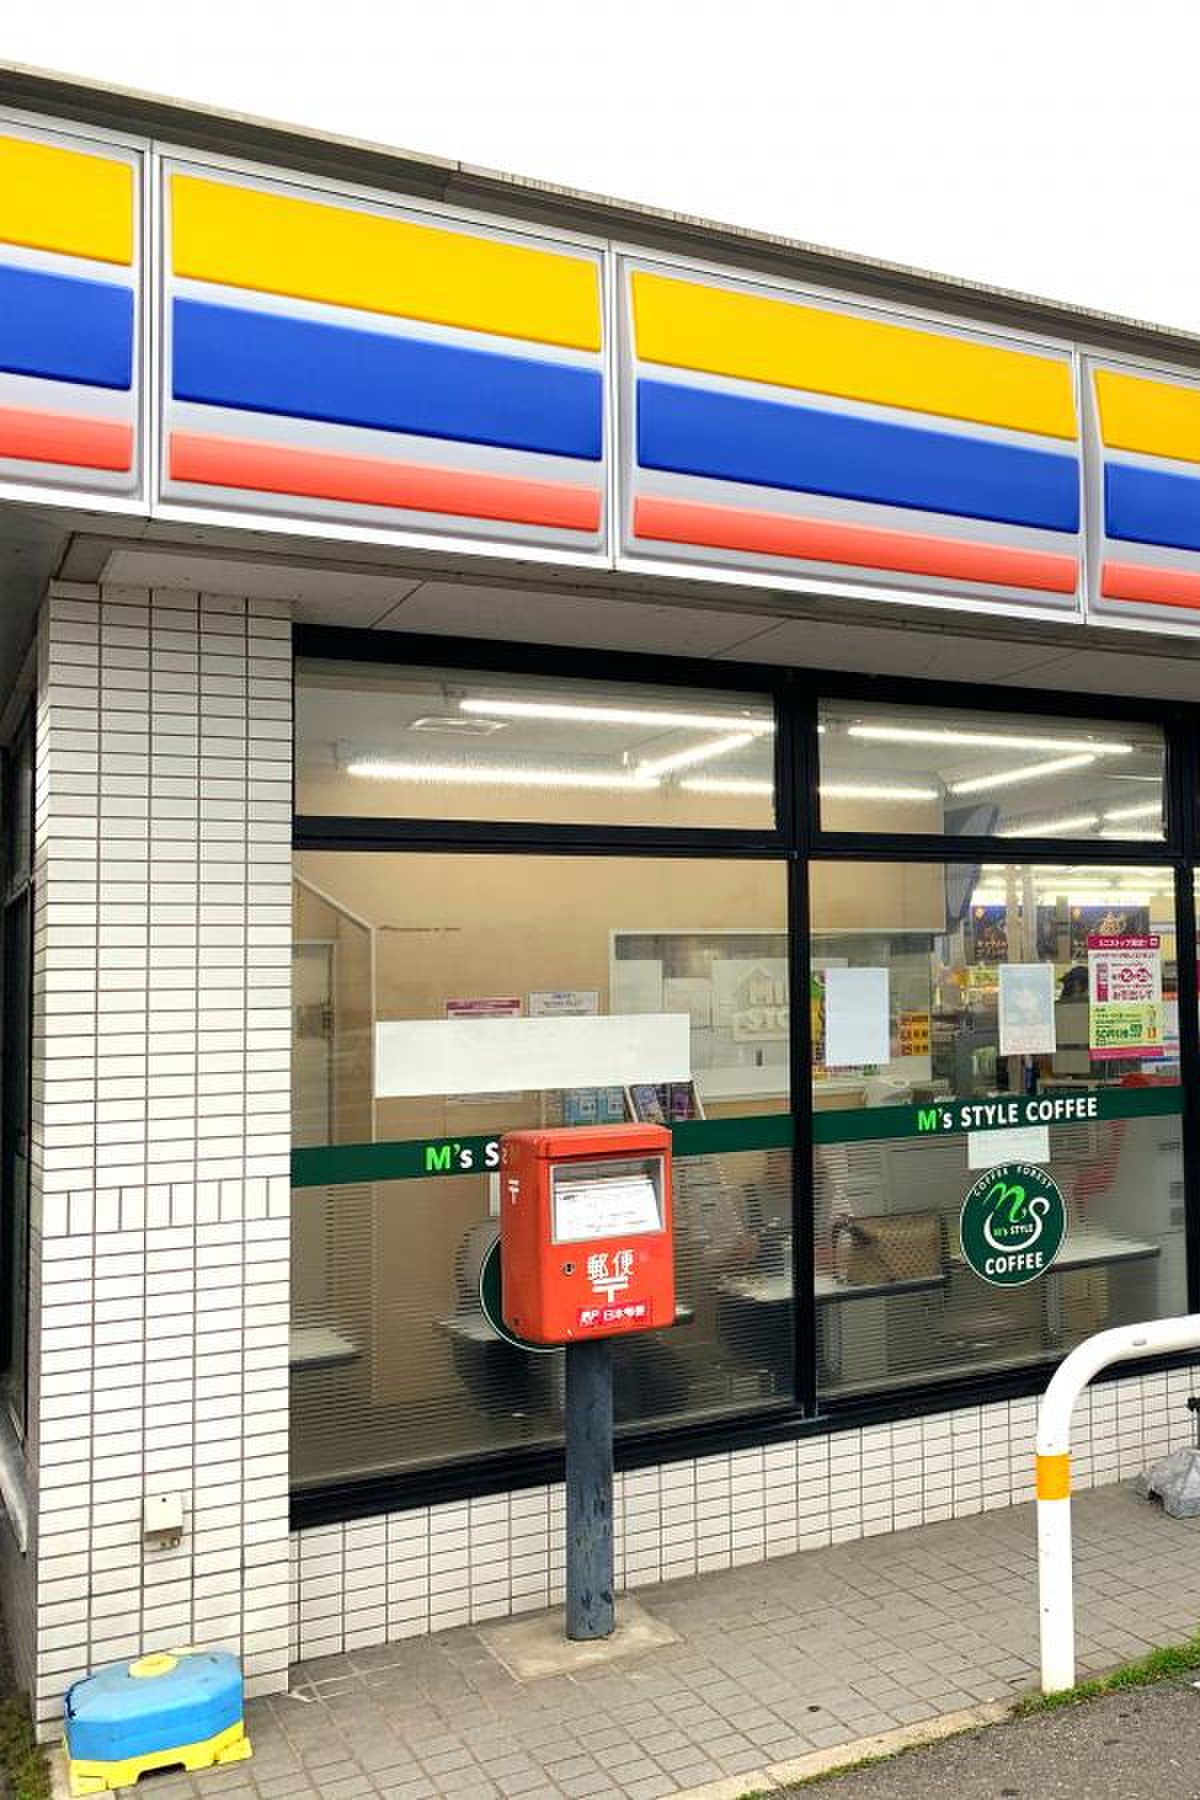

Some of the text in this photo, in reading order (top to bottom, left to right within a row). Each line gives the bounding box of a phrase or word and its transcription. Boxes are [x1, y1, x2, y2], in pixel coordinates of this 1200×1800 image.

[960, 1103, 1019, 1127] STYLE
[1025, 1097, 1098, 1121] COFFEE
[587, 1248, 634, 1281] 郵便
[985, 1251, 1043, 1275] COFFEE
